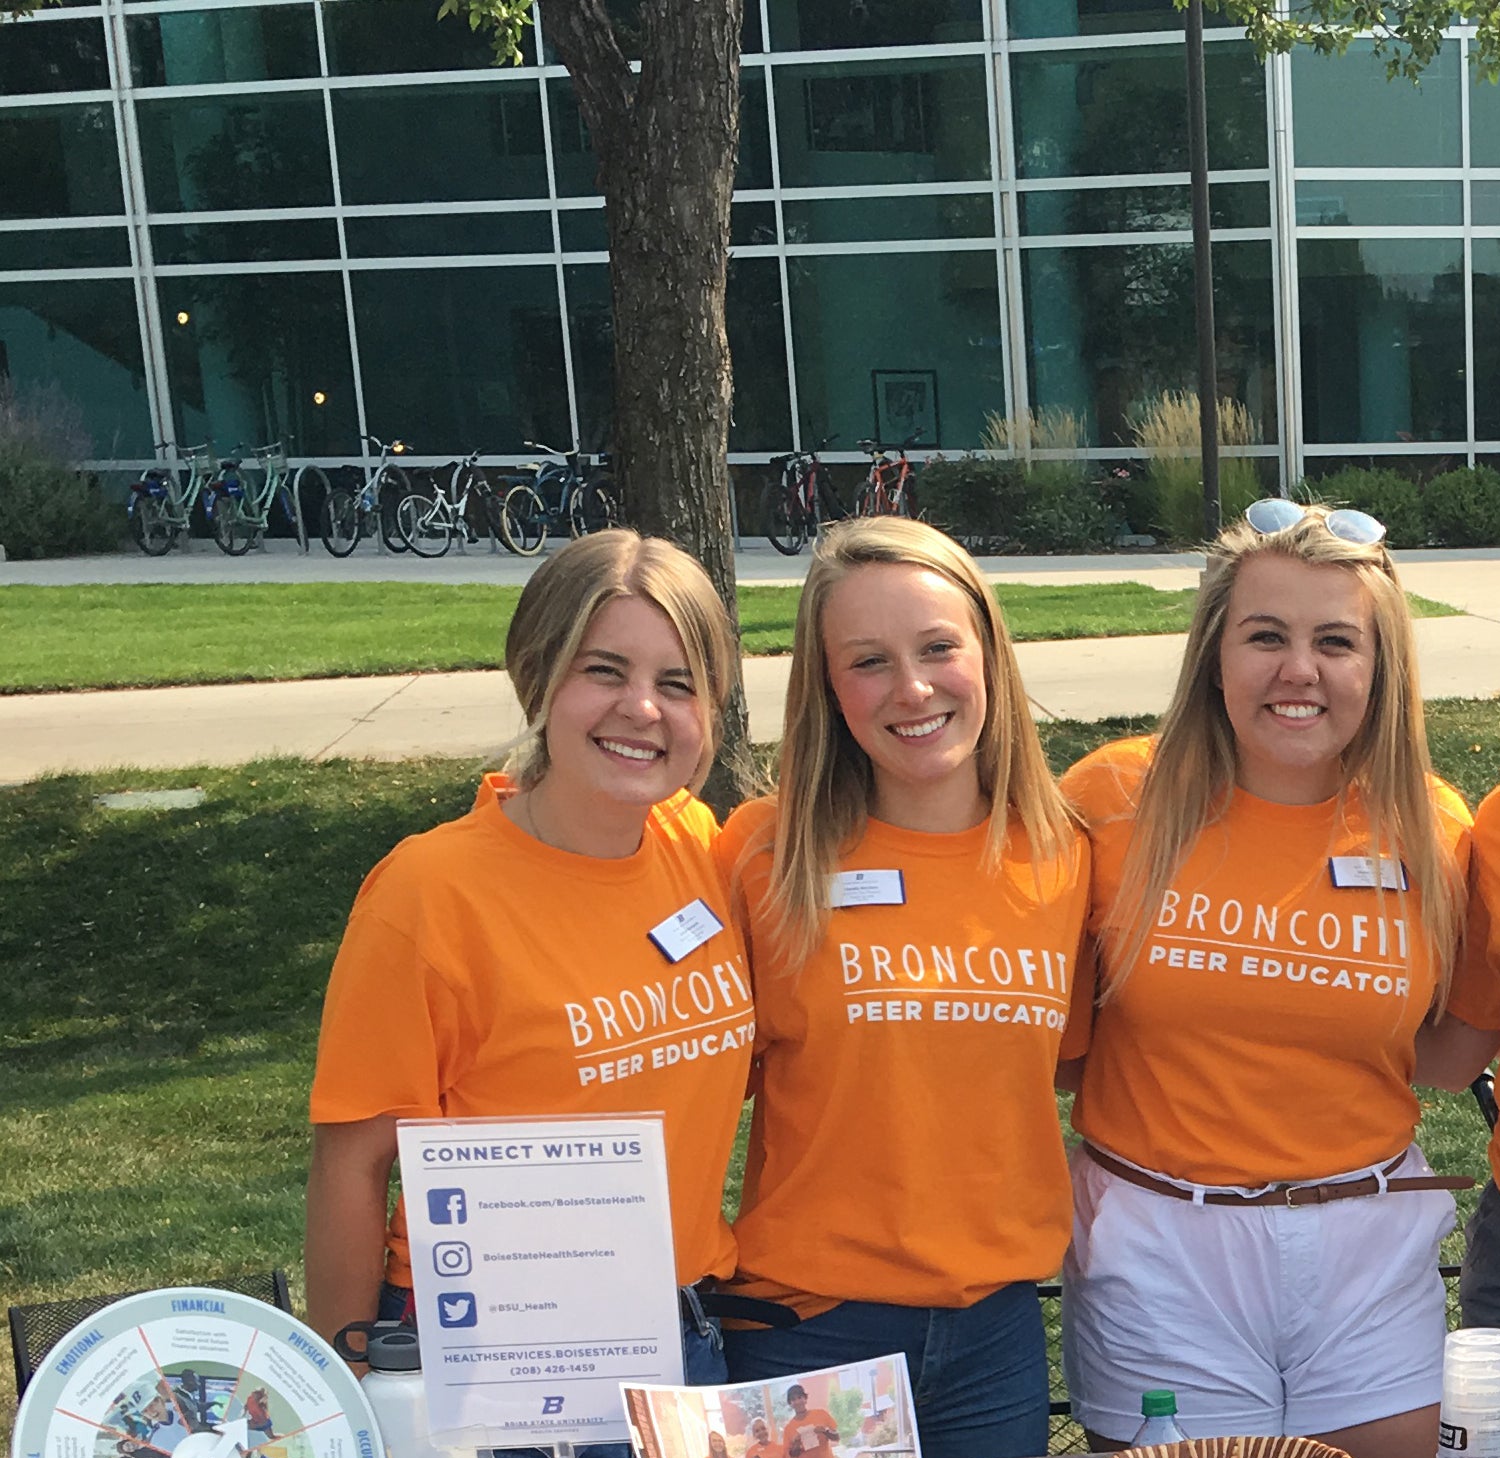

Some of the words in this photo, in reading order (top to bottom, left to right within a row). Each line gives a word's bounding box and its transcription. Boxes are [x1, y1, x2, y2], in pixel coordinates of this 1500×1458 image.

[1158, 889, 1409, 958] BRONCOFIT
[839, 943, 1066, 995] BRONCOFIT
[1149, 945, 1228, 973] PEER
[1241, 956, 1410, 998] EDUCATOR
[847, 1001, 922, 1025] PEER
[934, 1001, 1068, 1034] EDUCATOR
[578, 1054, 644, 1087] PEER
[652, 1020, 756, 1072] EDUCATO
[422, 1144, 534, 1164] CONNECT
[543, 1142, 604, 1160] WITH
[612, 1140, 642, 1156] US
[478, 1195, 646, 1211] facebook.com/BoiseStateHealth
[483, 1249, 615, 1263] BoiseStateHealthServices
[171, 1299, 226, 1314] FINANCIAL
[488, 1301, 558, 1315] @BSU_Health
[55, 1328, 105, 1376] EMOTIONAL
[288, 1331, 331, 1372] PHYSICAL
[444, 1345, 659, 1364] HEALTHSERVICES.BOISESTATE.EDU
[509, 1365, 542, 1376] (208)
[544, 1362, 596, 1375] 426-1459
